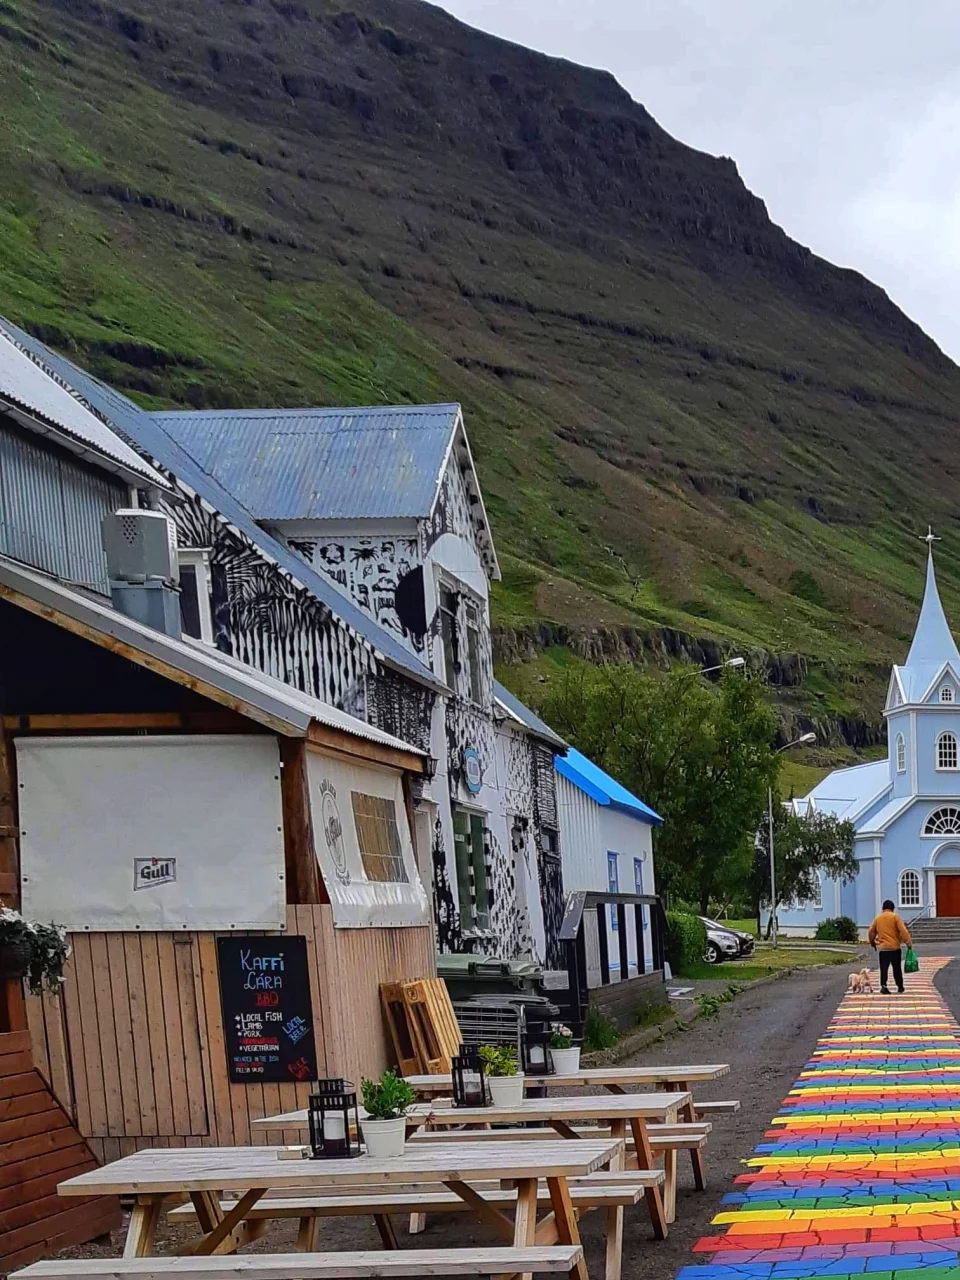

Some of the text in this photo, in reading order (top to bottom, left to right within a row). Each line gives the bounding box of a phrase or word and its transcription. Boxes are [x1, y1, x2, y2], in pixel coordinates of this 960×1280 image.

[141, 863, 170, 880] Gull
[256, 991, 279, 1006] BBQ
[241, 1013, 263, 1022] LOCAL
[282, 1016, 305, 1034] LOCAL
[242, 1022, 263, 1030] LAMB
